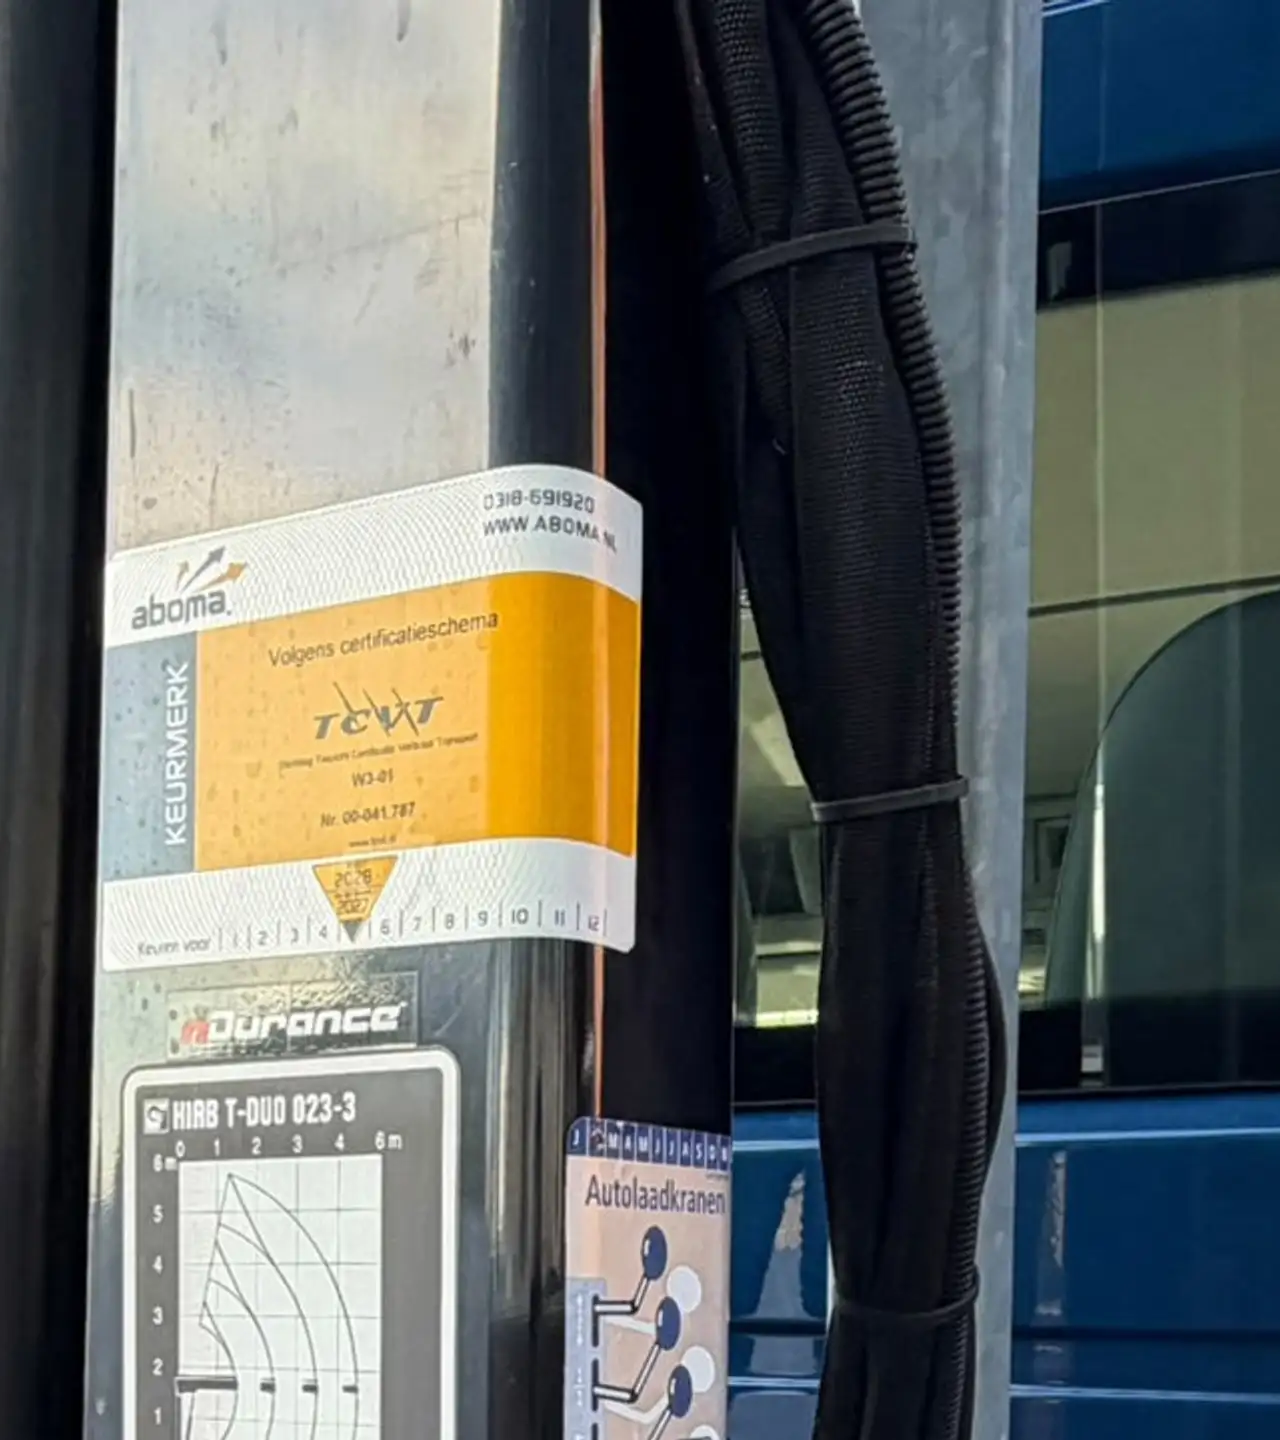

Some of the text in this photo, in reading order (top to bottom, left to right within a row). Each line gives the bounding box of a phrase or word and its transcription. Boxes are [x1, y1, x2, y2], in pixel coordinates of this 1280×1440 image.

[483, 489, 595, 514] 0318-691920
[268, 612, 498, 667] Volgens certificatieschema
[165, 661, 188, 845] KEURMERK
[257, 930, 268, 946] 2
[444, 913, 455, 930] 8
[477, 910, 489, 927] 9
[511, 908, 530, 925] 10
[553, 909, 566, 926] 11
[173, 1091, 356, 1131] HIAB T-DUO 023-3
[175, 1140, 186, 1157] 0
[213, 1137, 221, 1156] 1
[251, 1136, 262, 1154] 2
[292, 1134, 303, 1153] 3
[334, 1132, 345, 1151] 4
[388, 1133, 403, 1150] m
[572, 1130, 580, 1146] J
[695, 1143, 703, 1160] S
[584, 1173, 726, 1215] Autolaadkranen
[152, 1204, 163, 1223] 5
[152, 1255, 163, 1274] 4
[152, 1305, 163, 1325] 3
[152, 1357, 163, 1376] 2
[153, 1407, 162, 1425] 1
